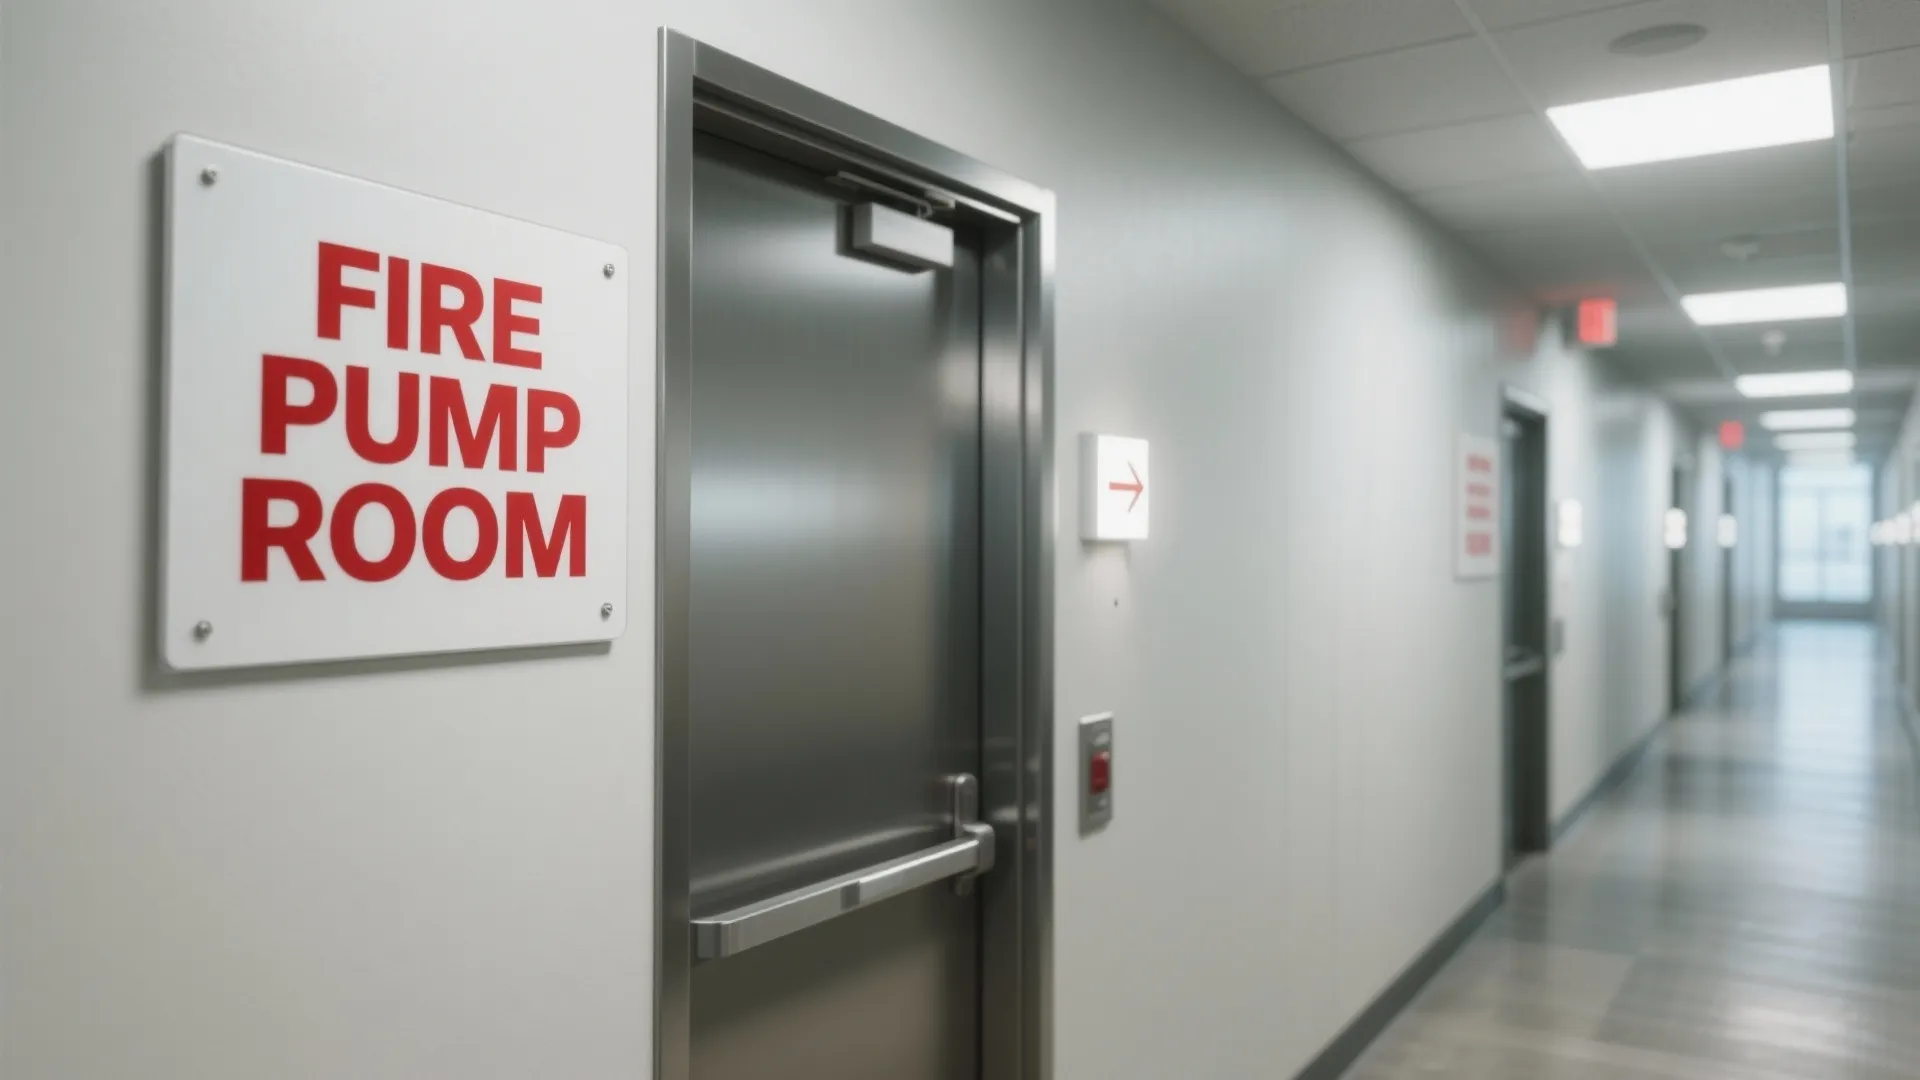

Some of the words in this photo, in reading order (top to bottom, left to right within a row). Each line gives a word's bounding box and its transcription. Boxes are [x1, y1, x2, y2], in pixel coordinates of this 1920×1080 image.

[317, 241, 543, 370] FIRE
[260, 354, 581, 473] PUMP
[241, 477, 587, 582] ROOM
